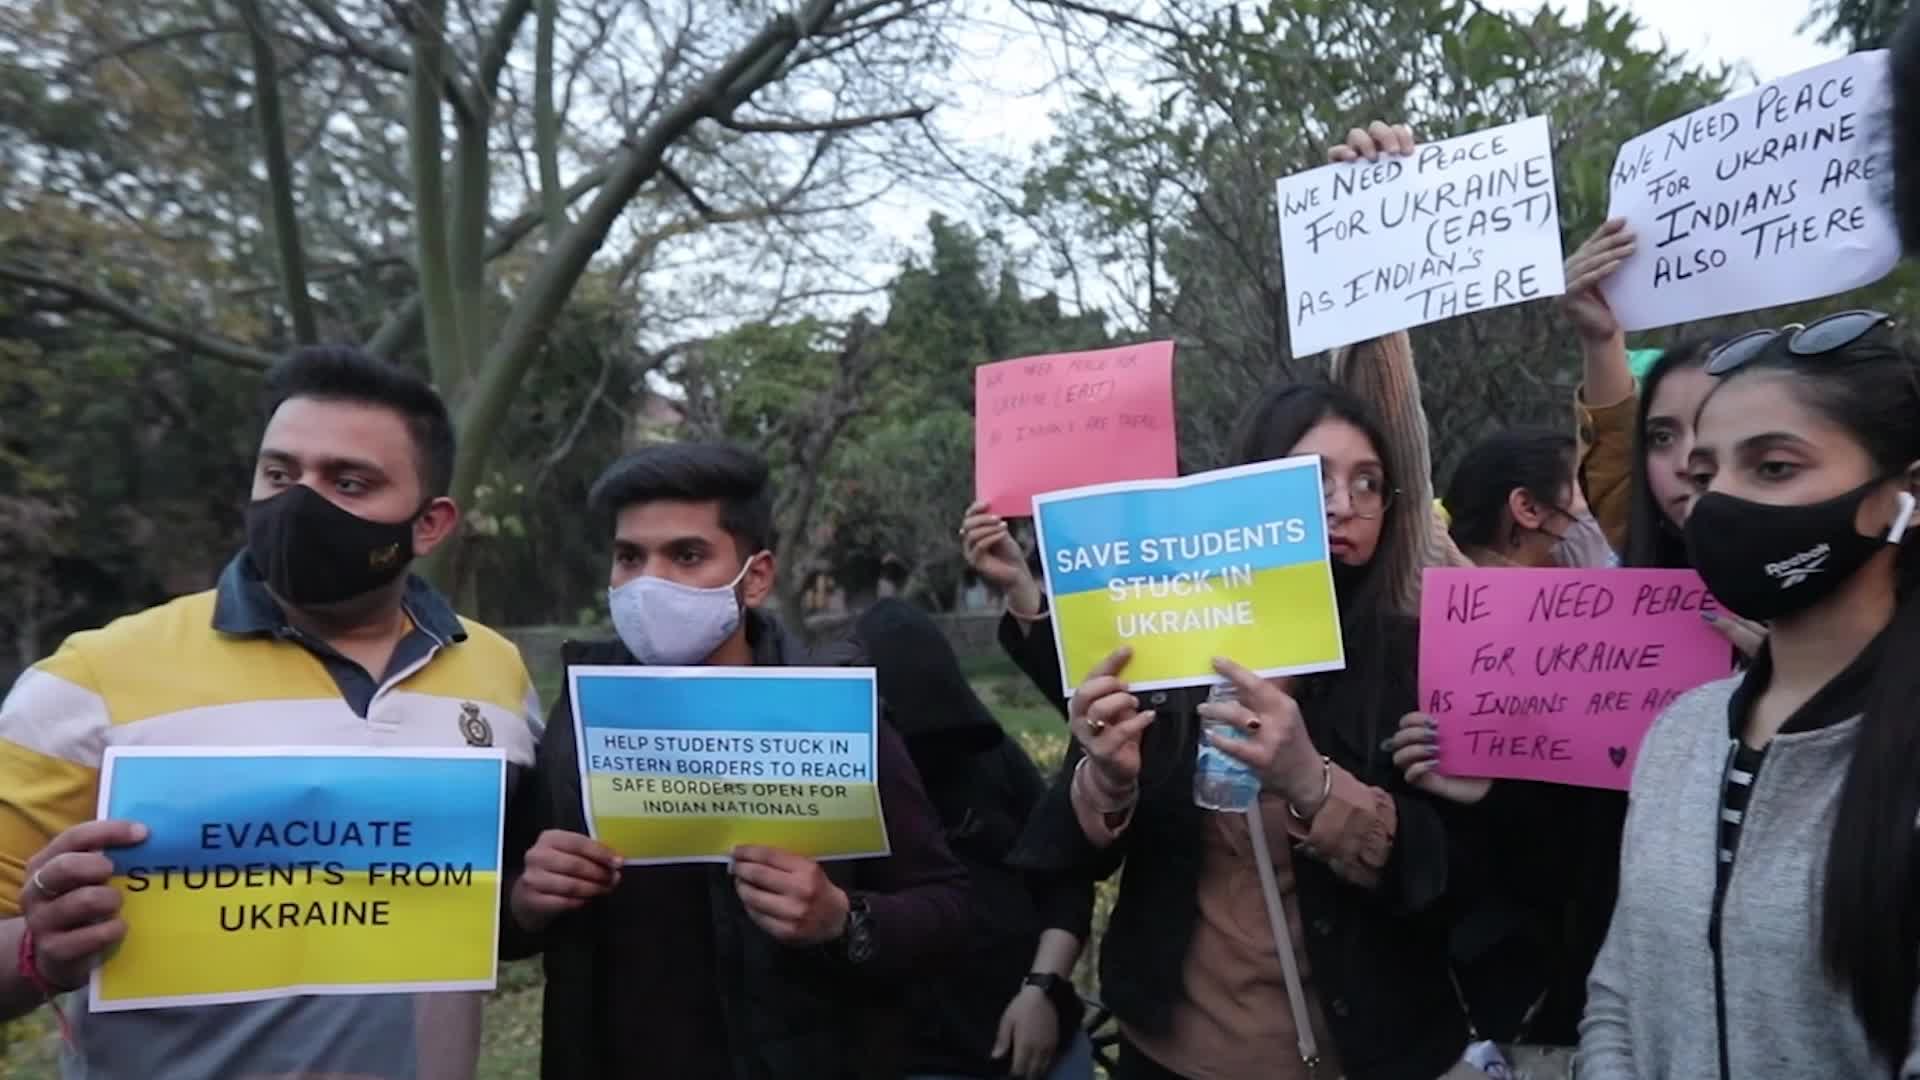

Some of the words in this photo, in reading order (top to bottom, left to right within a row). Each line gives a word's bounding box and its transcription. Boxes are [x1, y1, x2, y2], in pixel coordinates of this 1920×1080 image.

[1614, 144, 1653, 189] WE
[1664, 112, 1739, 161] NEED
[1756, 76, 1853, 129] PEACE
[1283, 187, 1320, 218] WE
[1333, 161, 1403, 200] NEED
[1417, 135, 1508, 174] PEACE
[1647, 170, 1691, 204] FOR
[1715, 113, 1857, 181] UKRAINE
[1305, 210, 1370, 254] FOR
[1381, 155, 1549, 228] UKRAINE
[1656, 179, 1798, 248] INDIANS
[1820, 154, 1877, 194] ARE
[1425, 192, 1551, 258] (EAST)
[1654, 249, 1727, 288] ALSO
[1741, 206, 1865, 259] THERE
[1297, 290, 1335, 326] AS
[1344, 245, 1484, 308] INDIAN'S
[1404, 264, 1540, 319] THERE
[1056, 541, 1130, 574] SAVE
[1140, 518, 1305, 563] STUDENTS
[1107, 569, 1213, 602] STUCK
[1222, 563, 1253, 589] IN
[1116, 601, 1254, 638] UKRAINE
[1447, 583, 1490, 624] WE
[1528, 582, 1615, 623] NEED
[1631, 583, 1719, 617] PEACE
[1470, 642, 1515, 675] FOR
[1535, 643, 1665, 676] UKRAINE
[1429, 689, 1454, 714] AS
[1470, 691, 1568, 717] INDIANS
[1584, 691, 1633, 715] ARE
[604, 735, 649, 751] HELP
[655, 736, 754, 753] STUDENTS
[760, 738, 824, 754] STUCK
[830, 739, 849, 754] IN
[1464, 730, 1573, 761] THERE
[591, 756, 671, 772] EASTERN
[677, 760, 764, 777] BORDERS
[770, 762, 795, 777] TO
[801, 762, 866, 778] REACH
[612, 778, 656, 793] SAFE
[662, 780, 747, 796] BORDERS
[753, 783, 803, 798] OPEN
[810, 784, 848, 798] FOR
[643, 800, 706, 814] INDIAN
[712, 801, 820, 817] NATIONALS
[201, 821, 413, 850] EVACUATE
[127, 861, 345, 892] STUDENTS
[369, 862, 473, 888] FROM
[220, 901, 390, 931] UKRAINE
